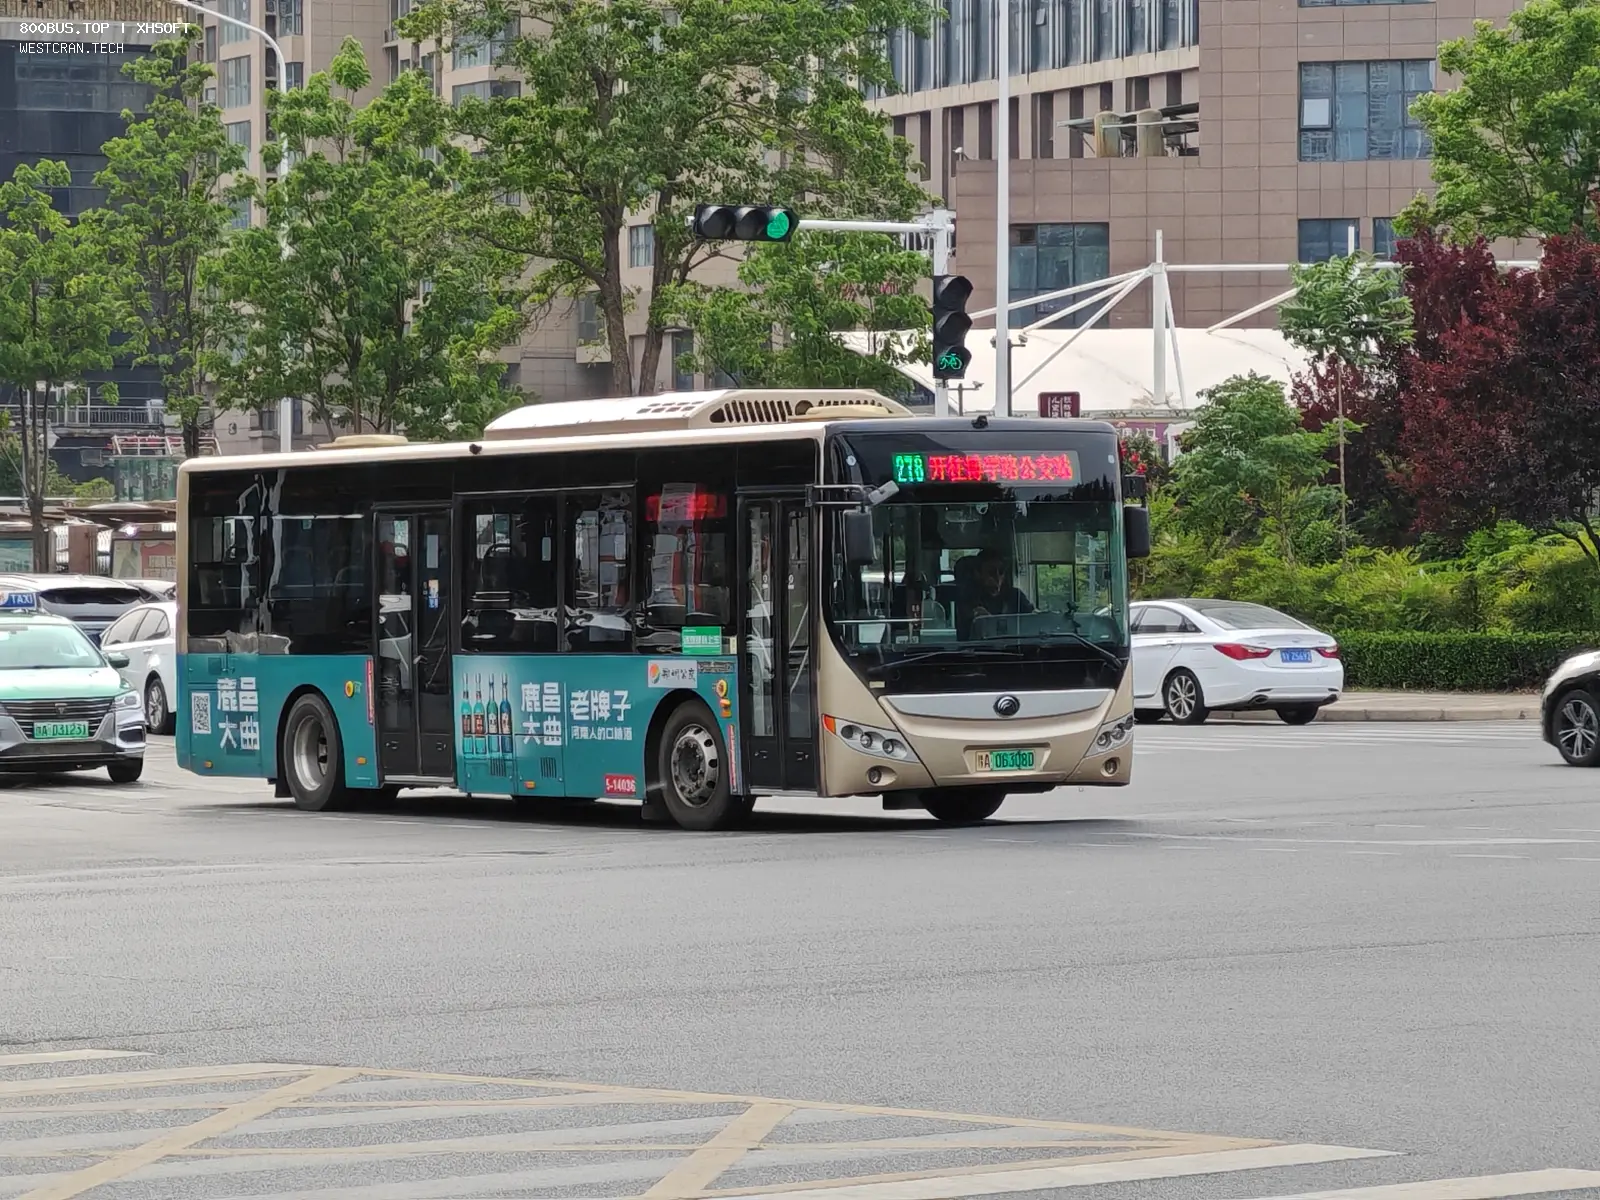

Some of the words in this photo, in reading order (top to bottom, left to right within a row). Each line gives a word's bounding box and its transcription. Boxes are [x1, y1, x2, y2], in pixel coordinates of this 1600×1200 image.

[10, 594, 33, 604] TAXI
[217, 677, 259, 712] 鹿邑
[521, 681, 561, 713] 鹿邑
[570, 689, 632, 722] 老牌子
[218, 714, 260, 750] 大曲
[522, 713, 562, 746] 大曲
